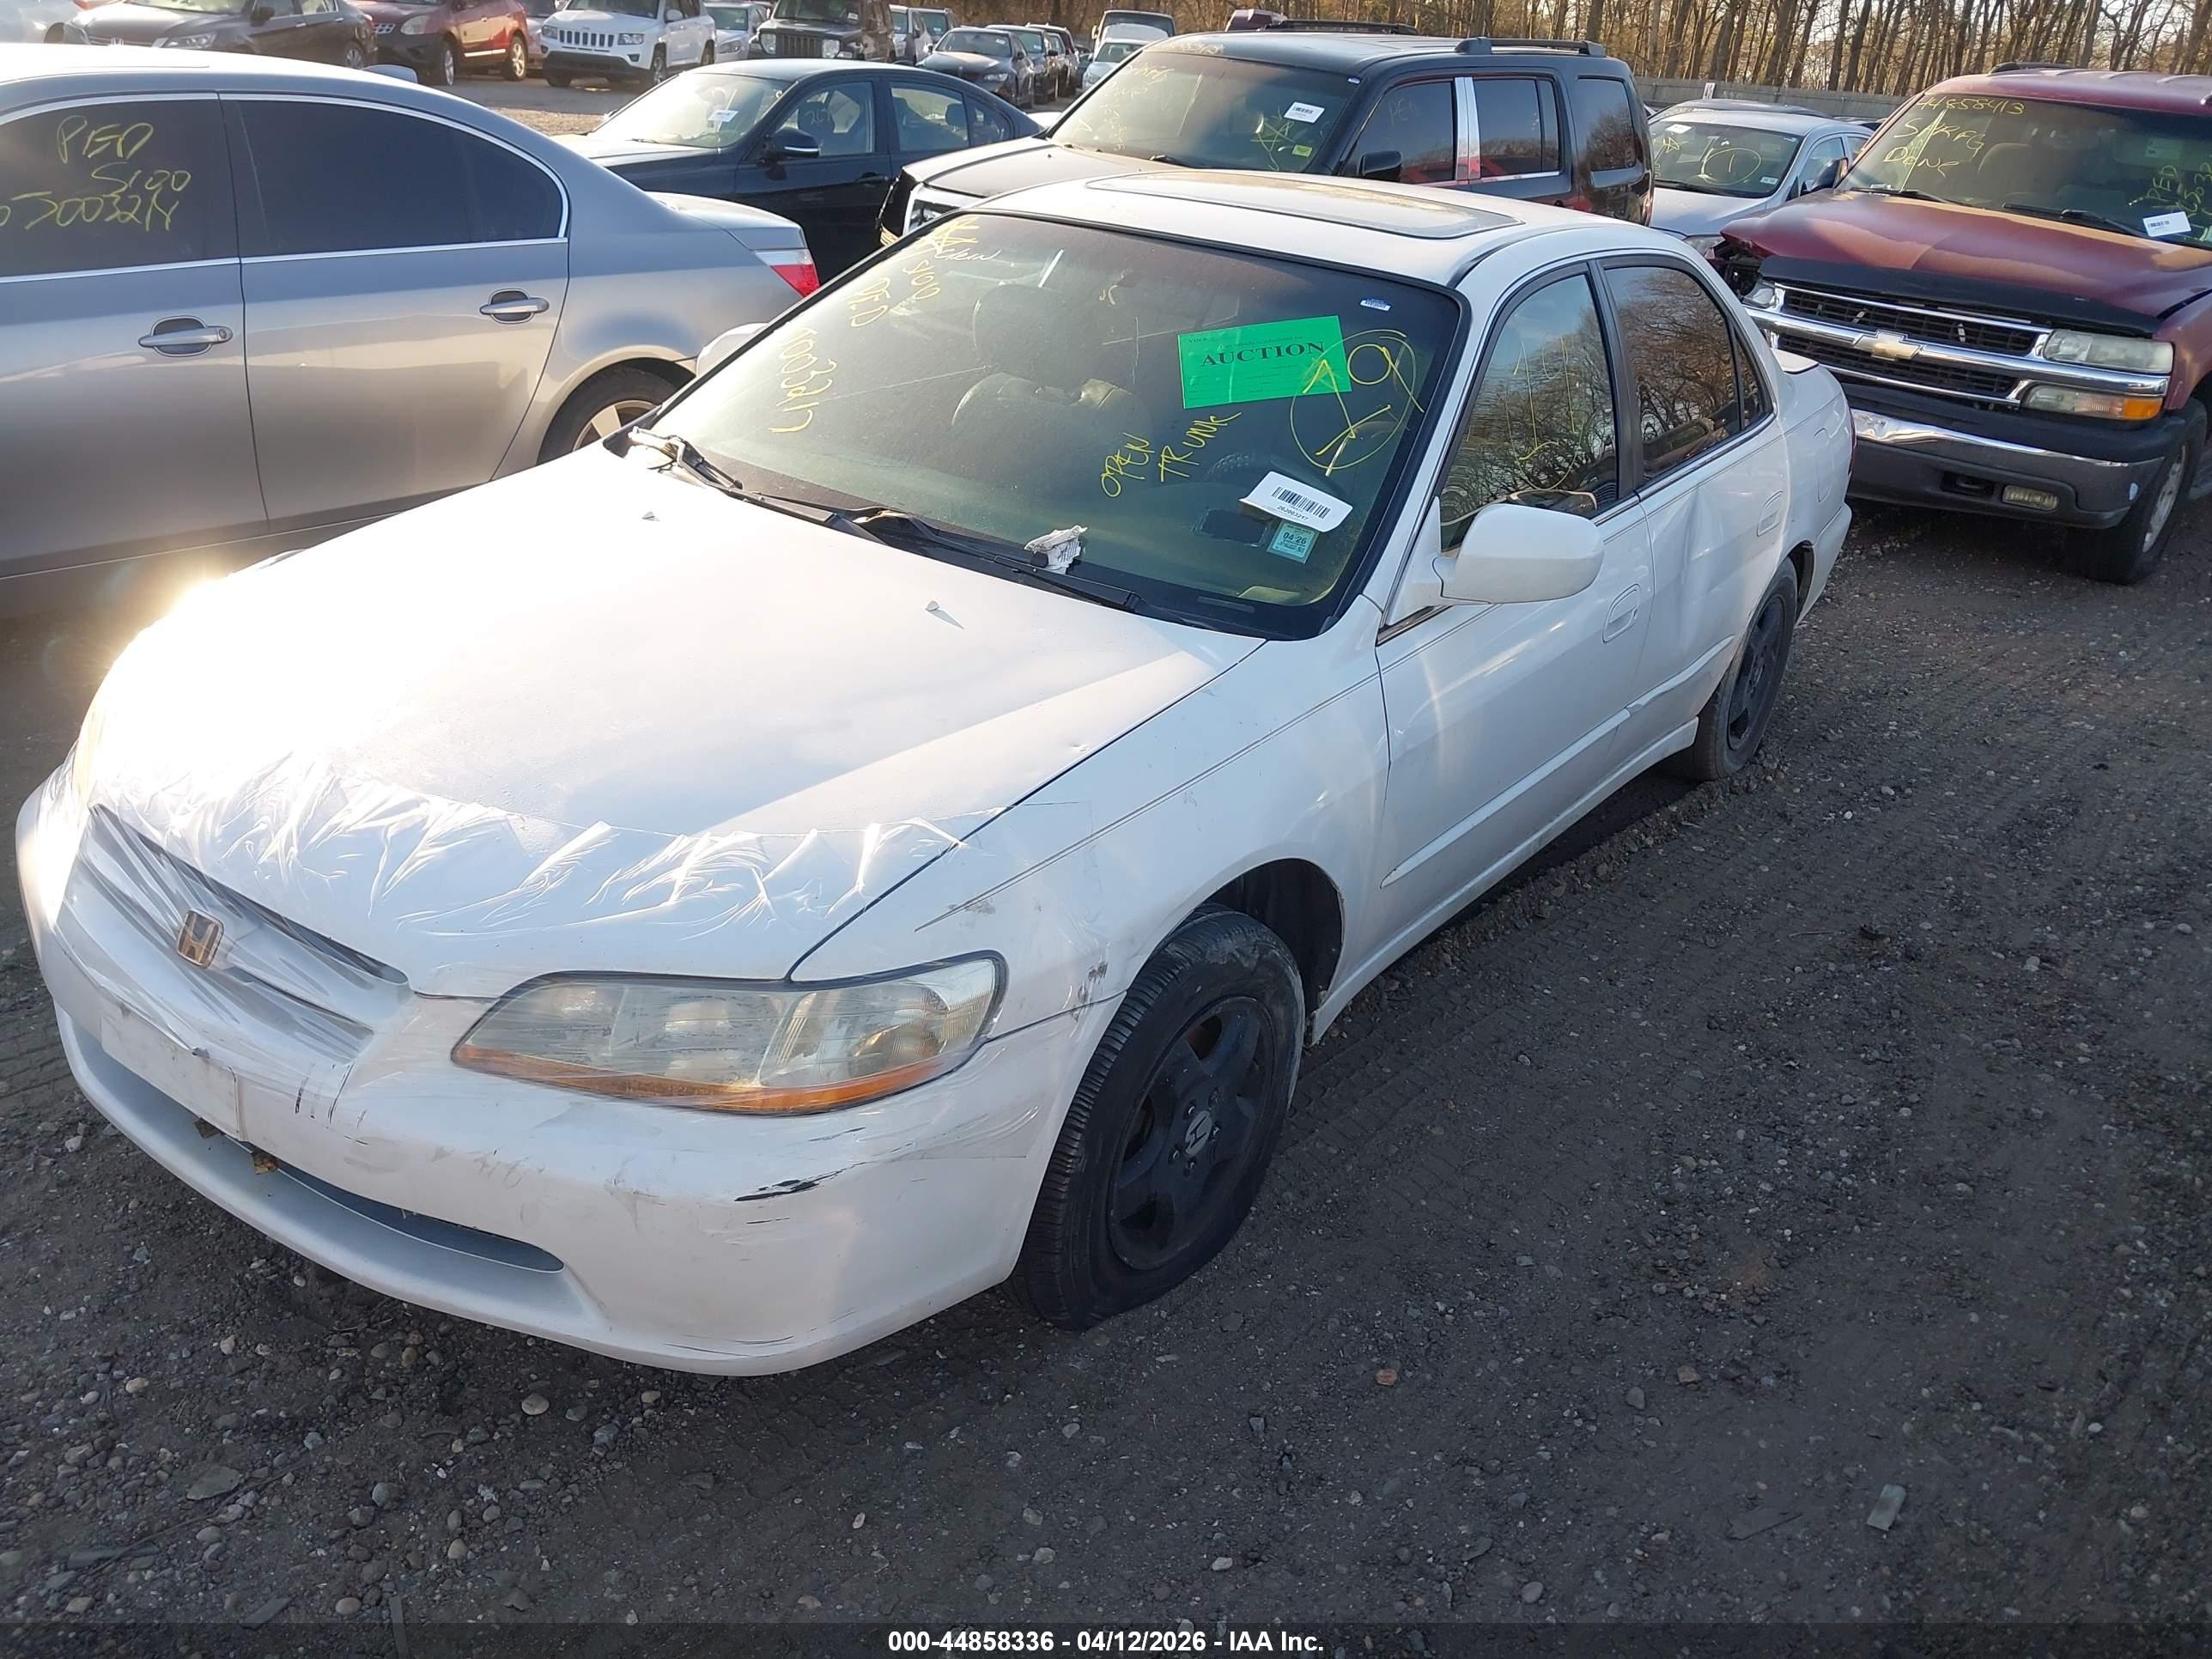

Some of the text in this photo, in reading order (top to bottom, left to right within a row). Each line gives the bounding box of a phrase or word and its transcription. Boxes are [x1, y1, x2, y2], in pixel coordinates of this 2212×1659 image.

[56, 114, 155, 165] PED
[1201, 341, 1326, 367] AUCTION
[1100, 432, 1156, 498] OPEN
